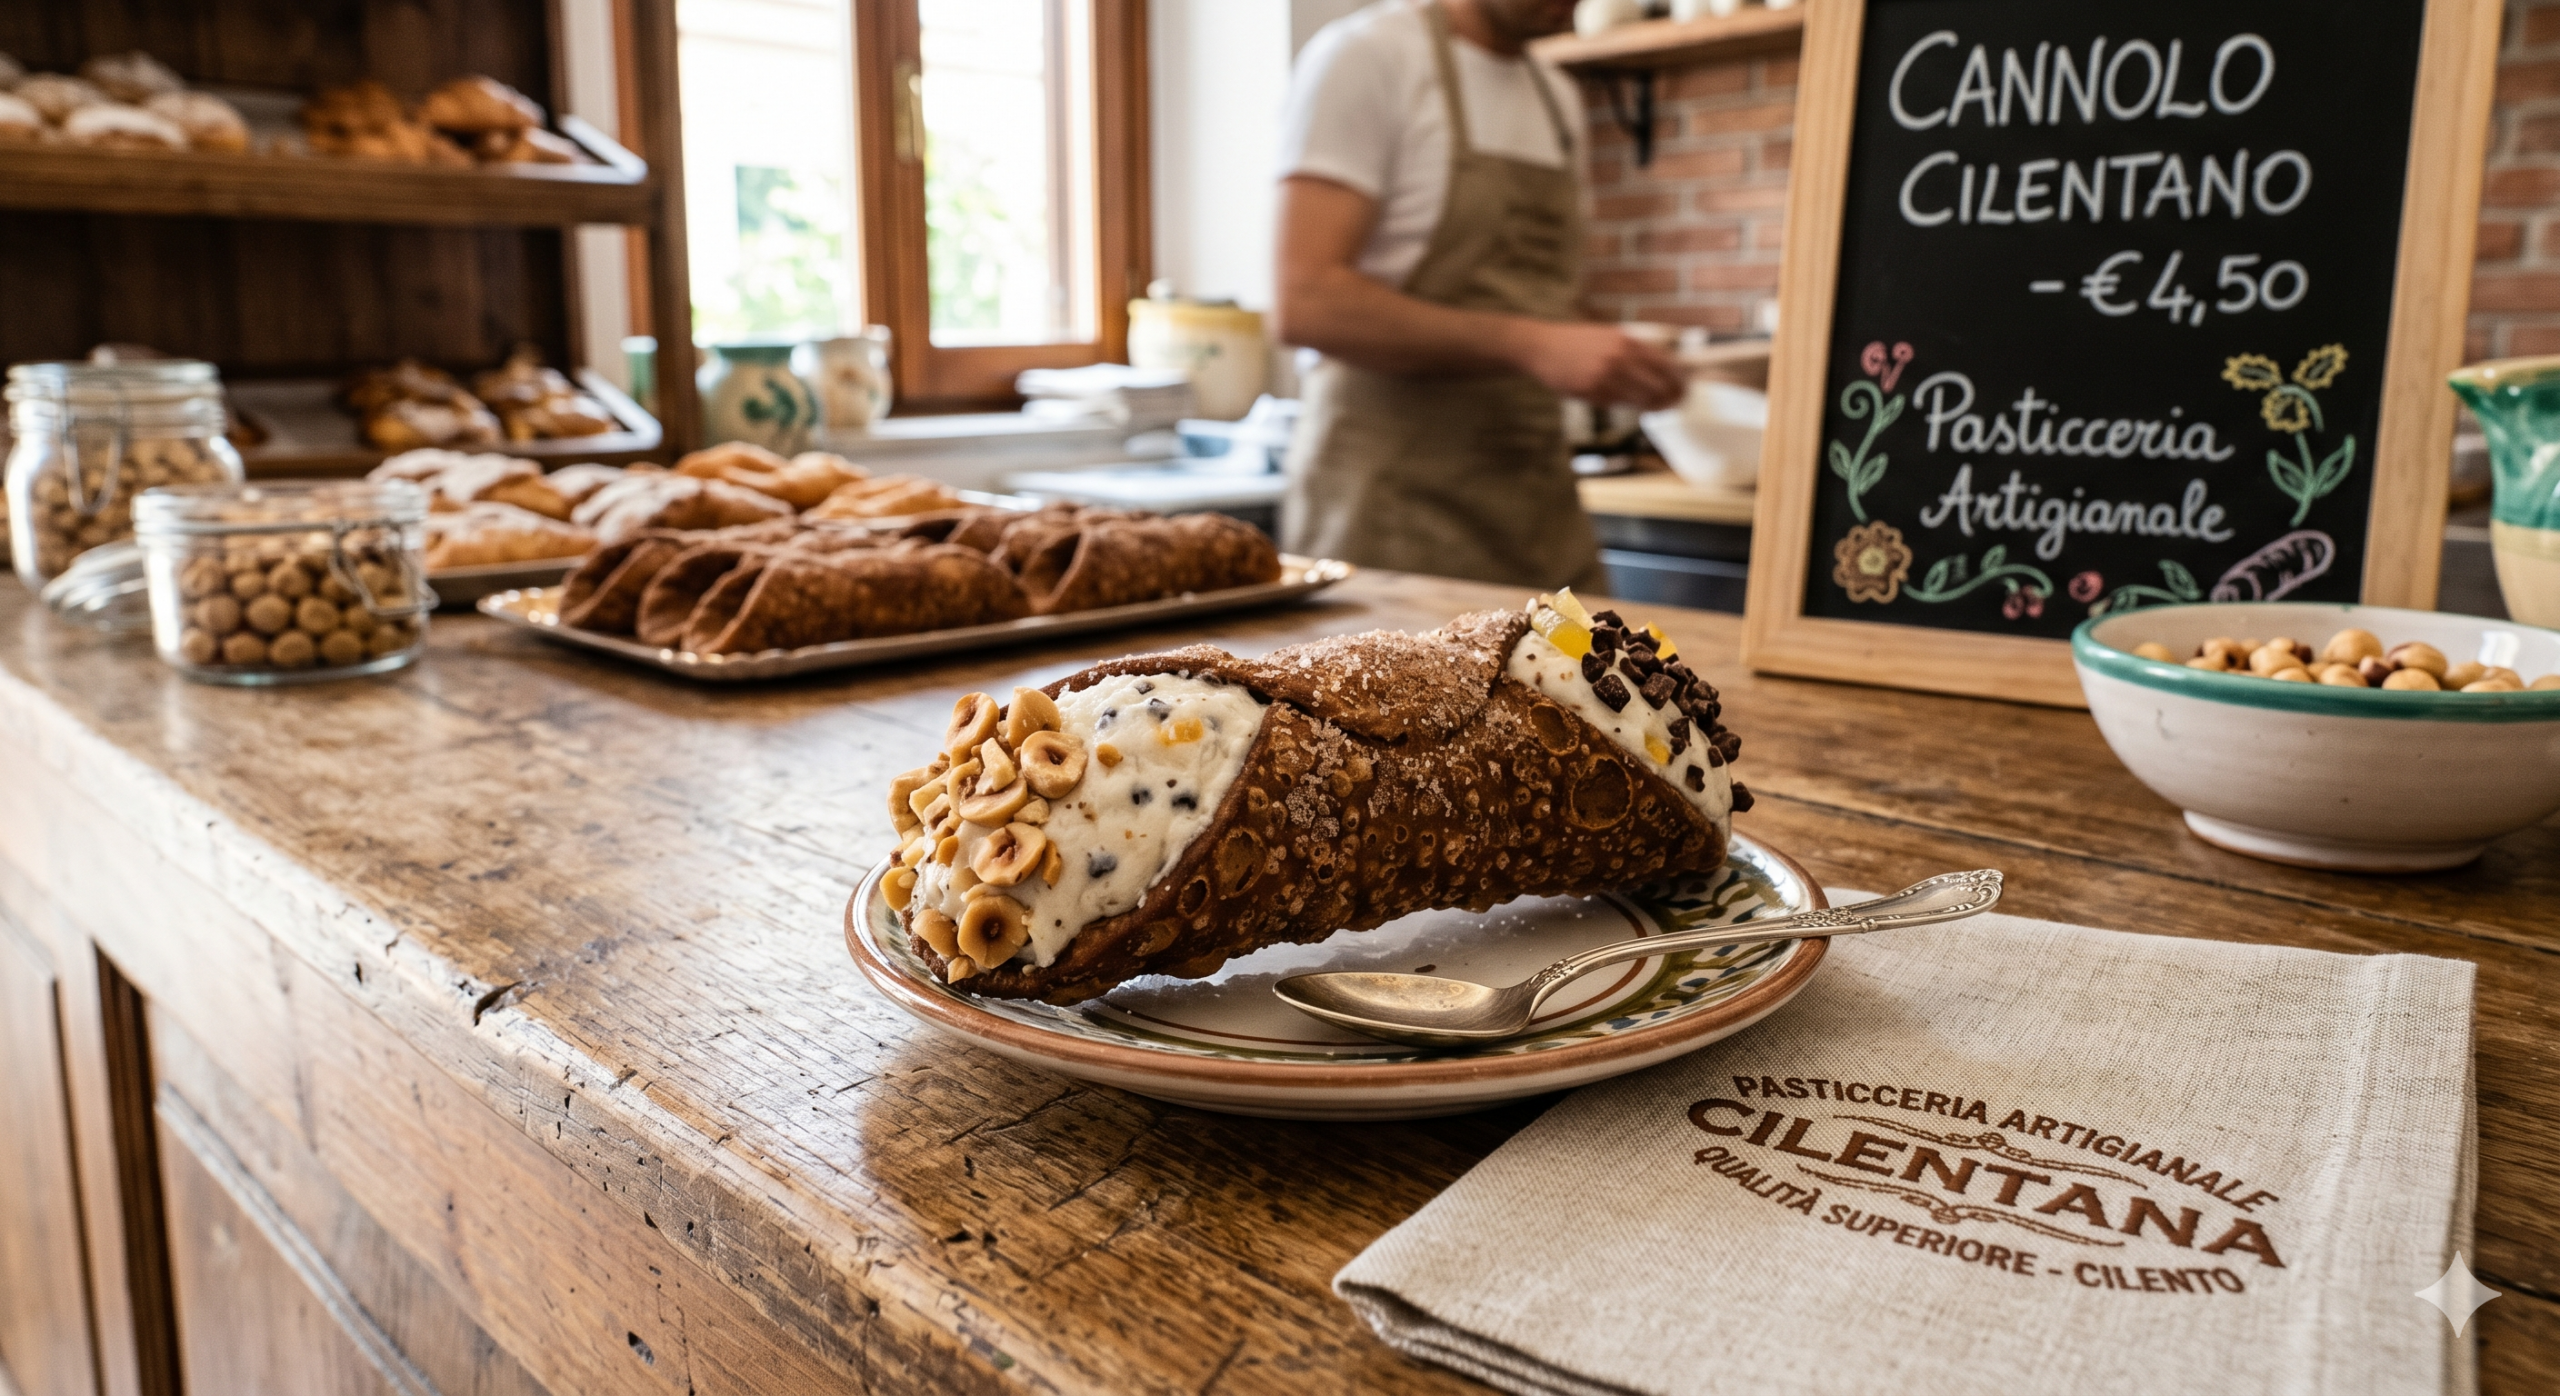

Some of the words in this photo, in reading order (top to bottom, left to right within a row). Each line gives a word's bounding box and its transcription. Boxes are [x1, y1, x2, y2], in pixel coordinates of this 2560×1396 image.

[1889, 30, 2276, 131] CANNOLO
[1898, 148, 2312, 226] CILENTANO
[1913, 371, 2236, 461] Pasticceria
[1919, 464, 2236, 560] Artigianale
[1687, 1098, 2287, 1269] CILENTANA
[1732, 1075, 1989, 1125] PASTICCERIA
[1998, 1108, 2280, 1213] ARTIGIANALE
[1694, 1146, 1822, 1216] QUALITÀ
[1821, 1204, 2037, 1277] SUPERIORE
[2074, 1261, 2246, 1294] CILENTO
